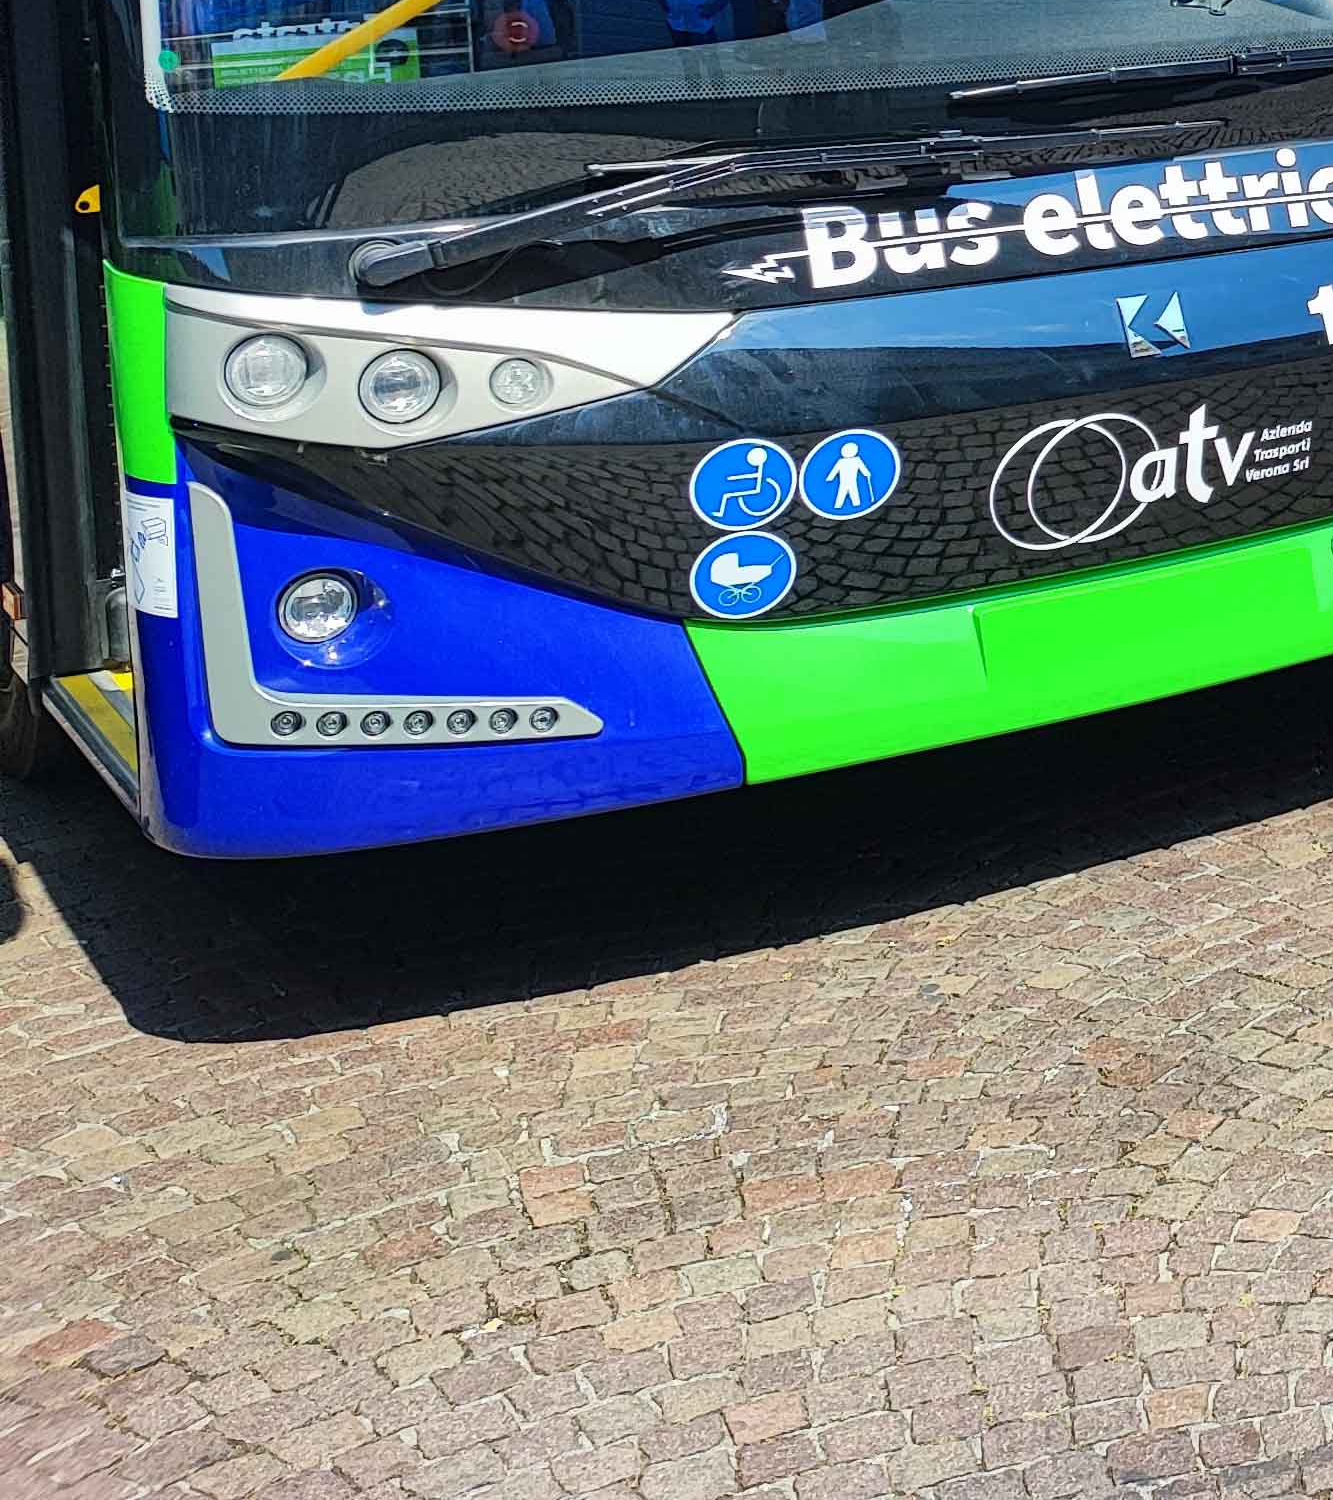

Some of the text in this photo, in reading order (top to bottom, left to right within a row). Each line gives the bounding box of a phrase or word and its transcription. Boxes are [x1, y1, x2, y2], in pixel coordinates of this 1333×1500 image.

[801, 199, 1000, 288] Bus
[1260, 420, 1313, 442] Azienda
[1129, 403, 1256, 504] atv
[1253, 437, 1311, 462] Trasporti
[1245, 456, 1311, 483] Verona Srl
